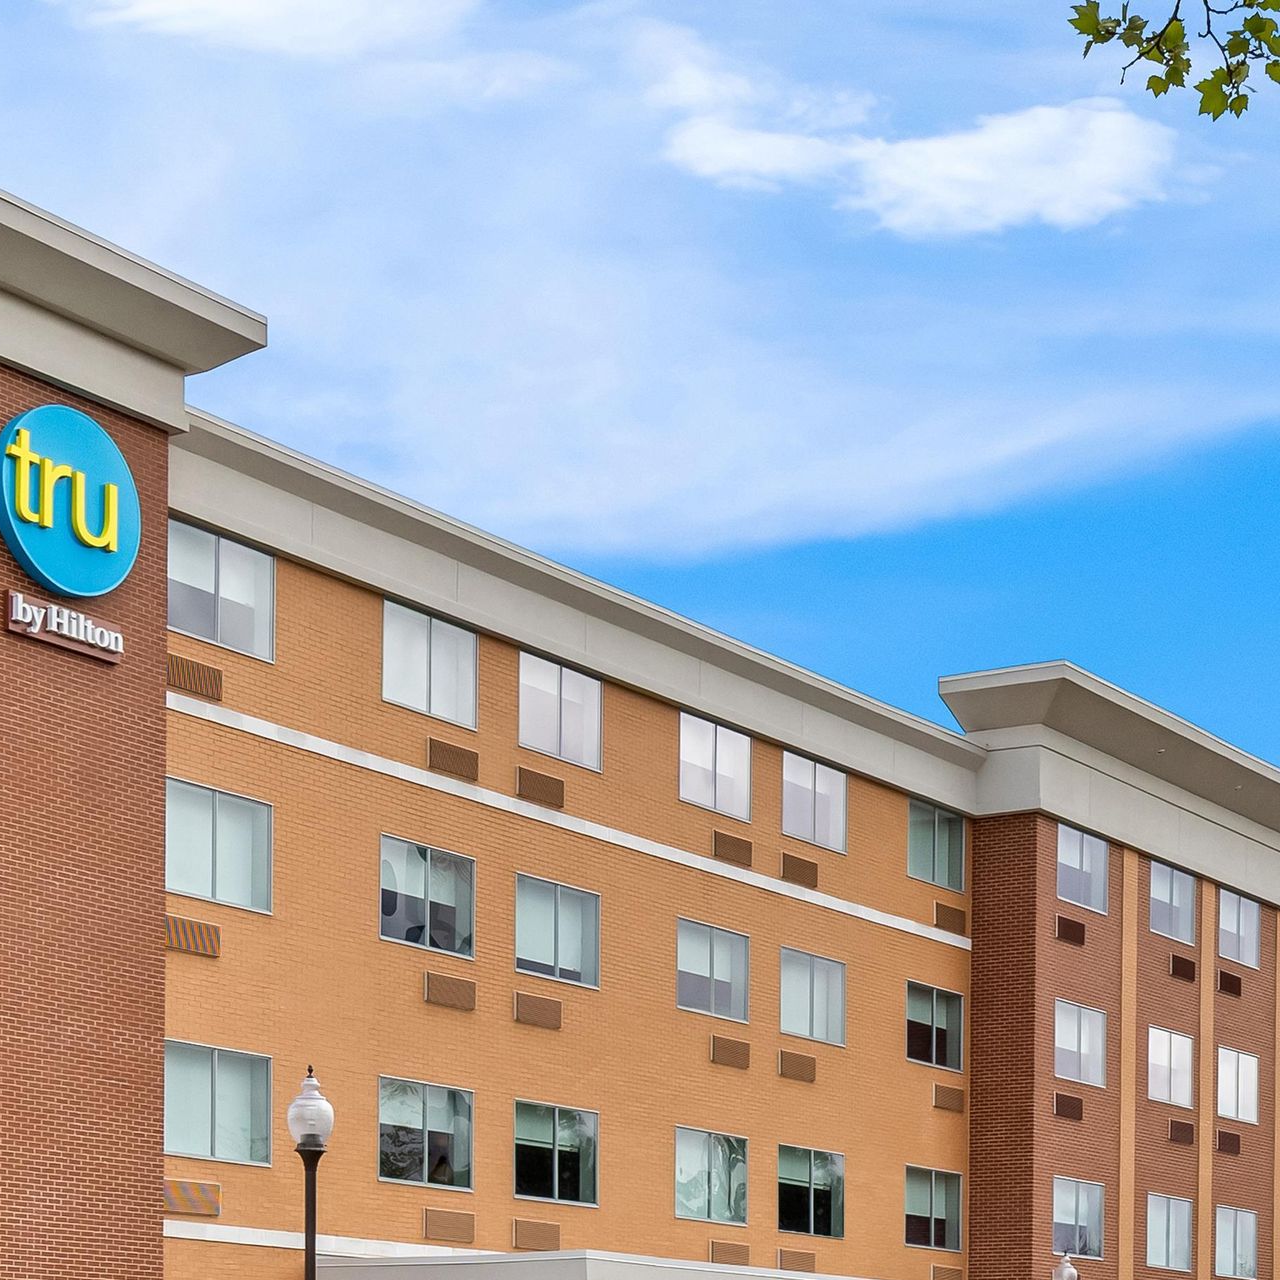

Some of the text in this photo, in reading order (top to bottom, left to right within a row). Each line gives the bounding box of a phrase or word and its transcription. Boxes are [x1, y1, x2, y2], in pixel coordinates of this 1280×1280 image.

[6, 428, 118, 552] tru
[11, 592, 124, 653] by Hilton
